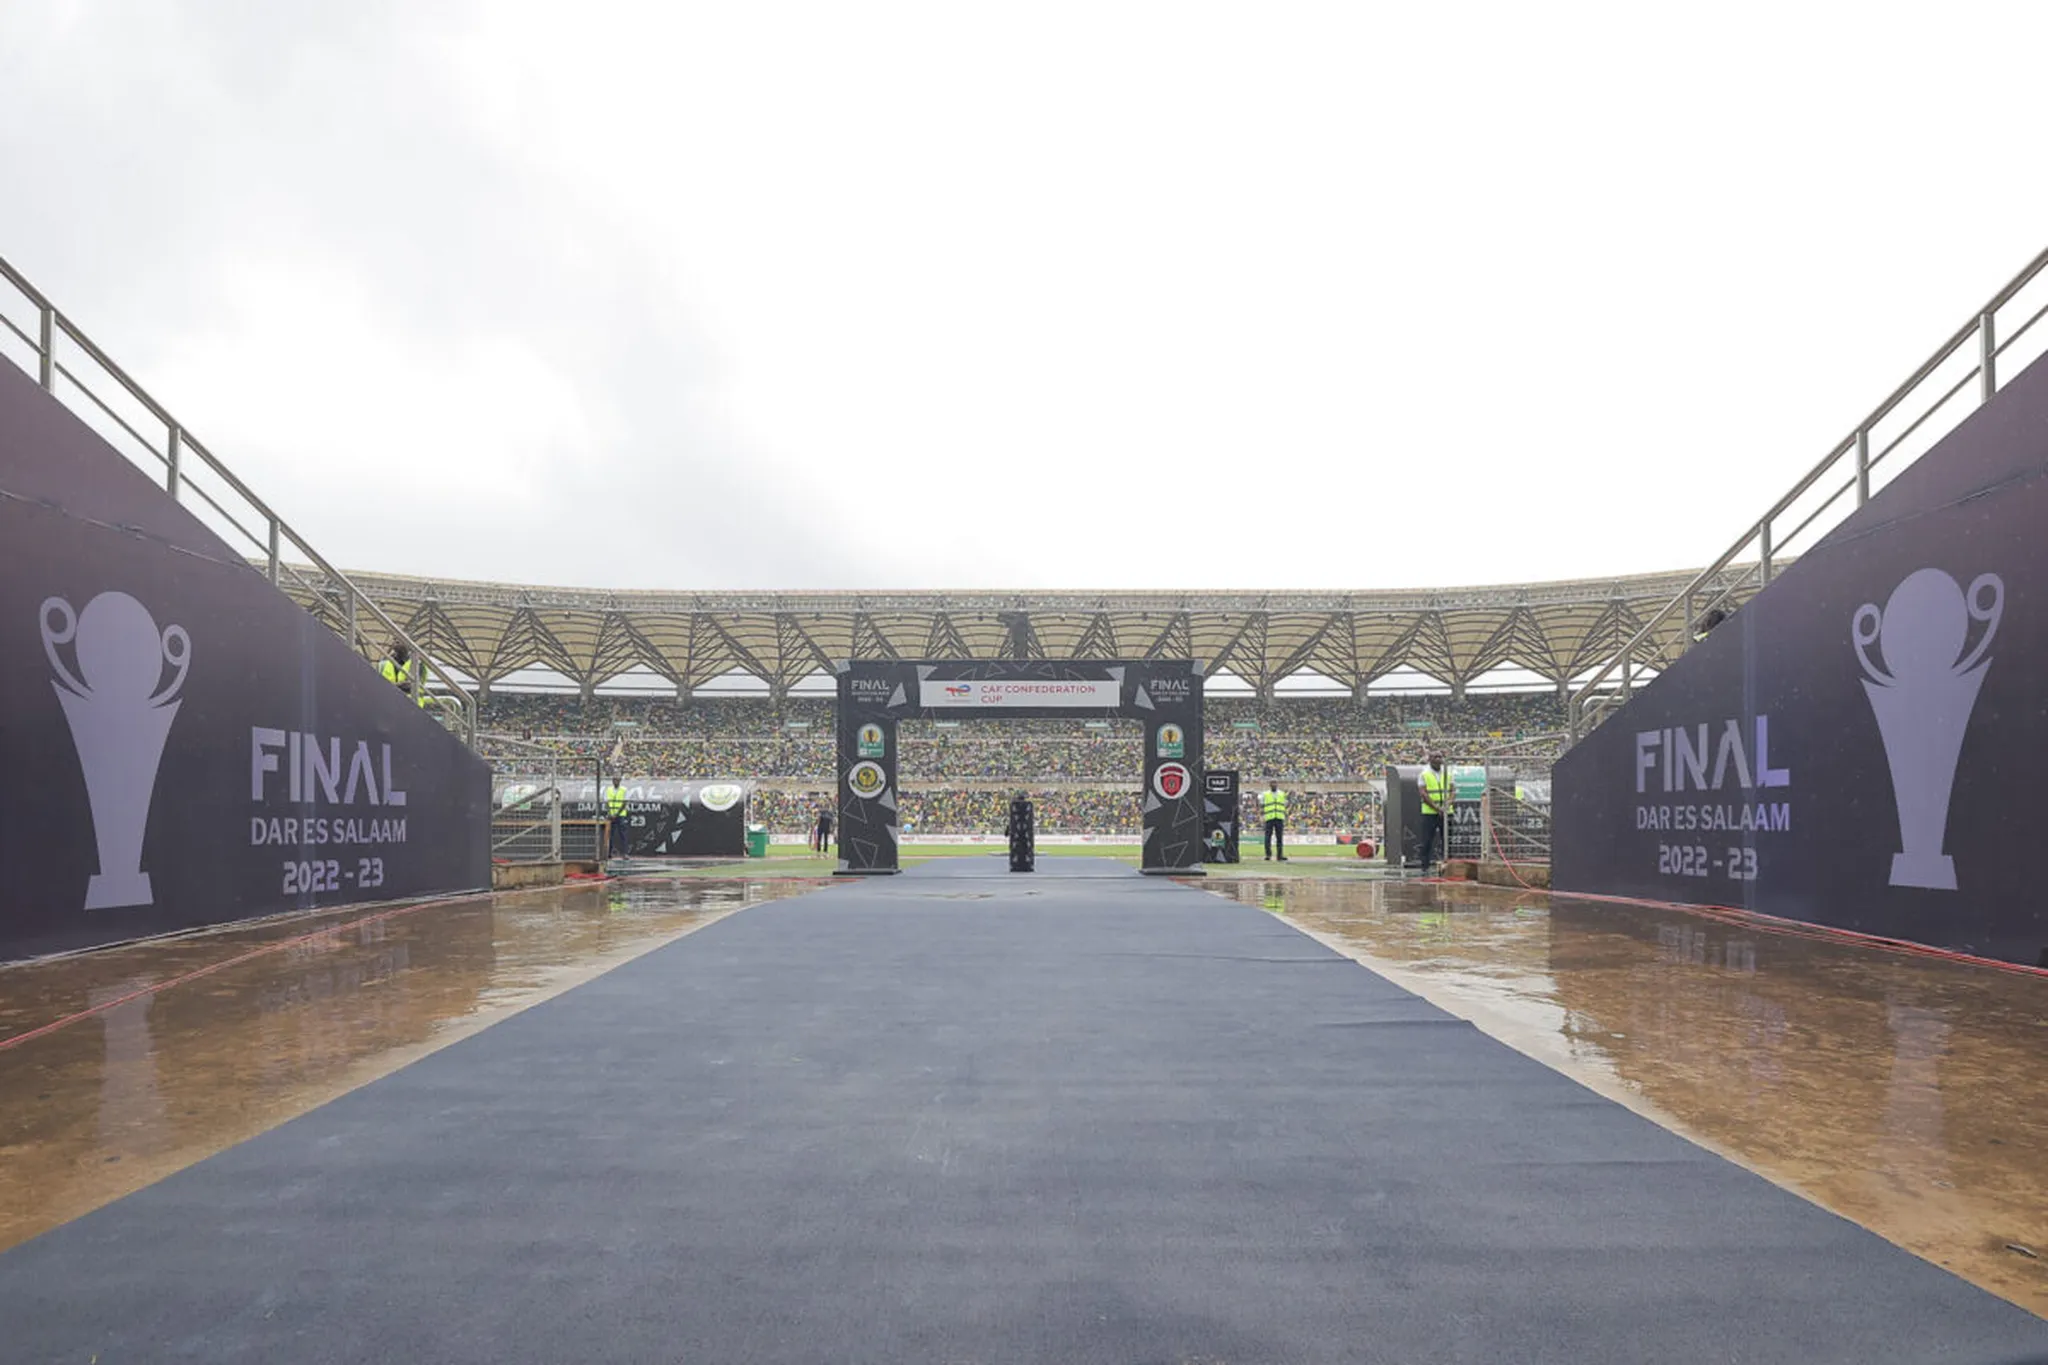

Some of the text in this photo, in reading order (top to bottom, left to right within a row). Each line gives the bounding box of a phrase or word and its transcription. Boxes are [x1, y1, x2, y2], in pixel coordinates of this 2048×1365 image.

[851, 679, 889, 690] FINAL
[980, 685, 1096, 694] CAF CONFEDERATION
[1150, 679, 1190, 690] FINAL
[980, 695, 1003, 704] CUP
[252, 726, 407, 806] FINAL
[1636, 714, 1790, 793] FINAL
[251, 817, 407, 845] DAR ES SALAAM
[1636, 803, 1790, 831] DAR ES SALAAM
[283, 860, 340, 895] 2022
[358, 857, 383, 888] 23
[1659, 844, 1708, 877] 2022
[1728, 847, 1758, 880] 23
